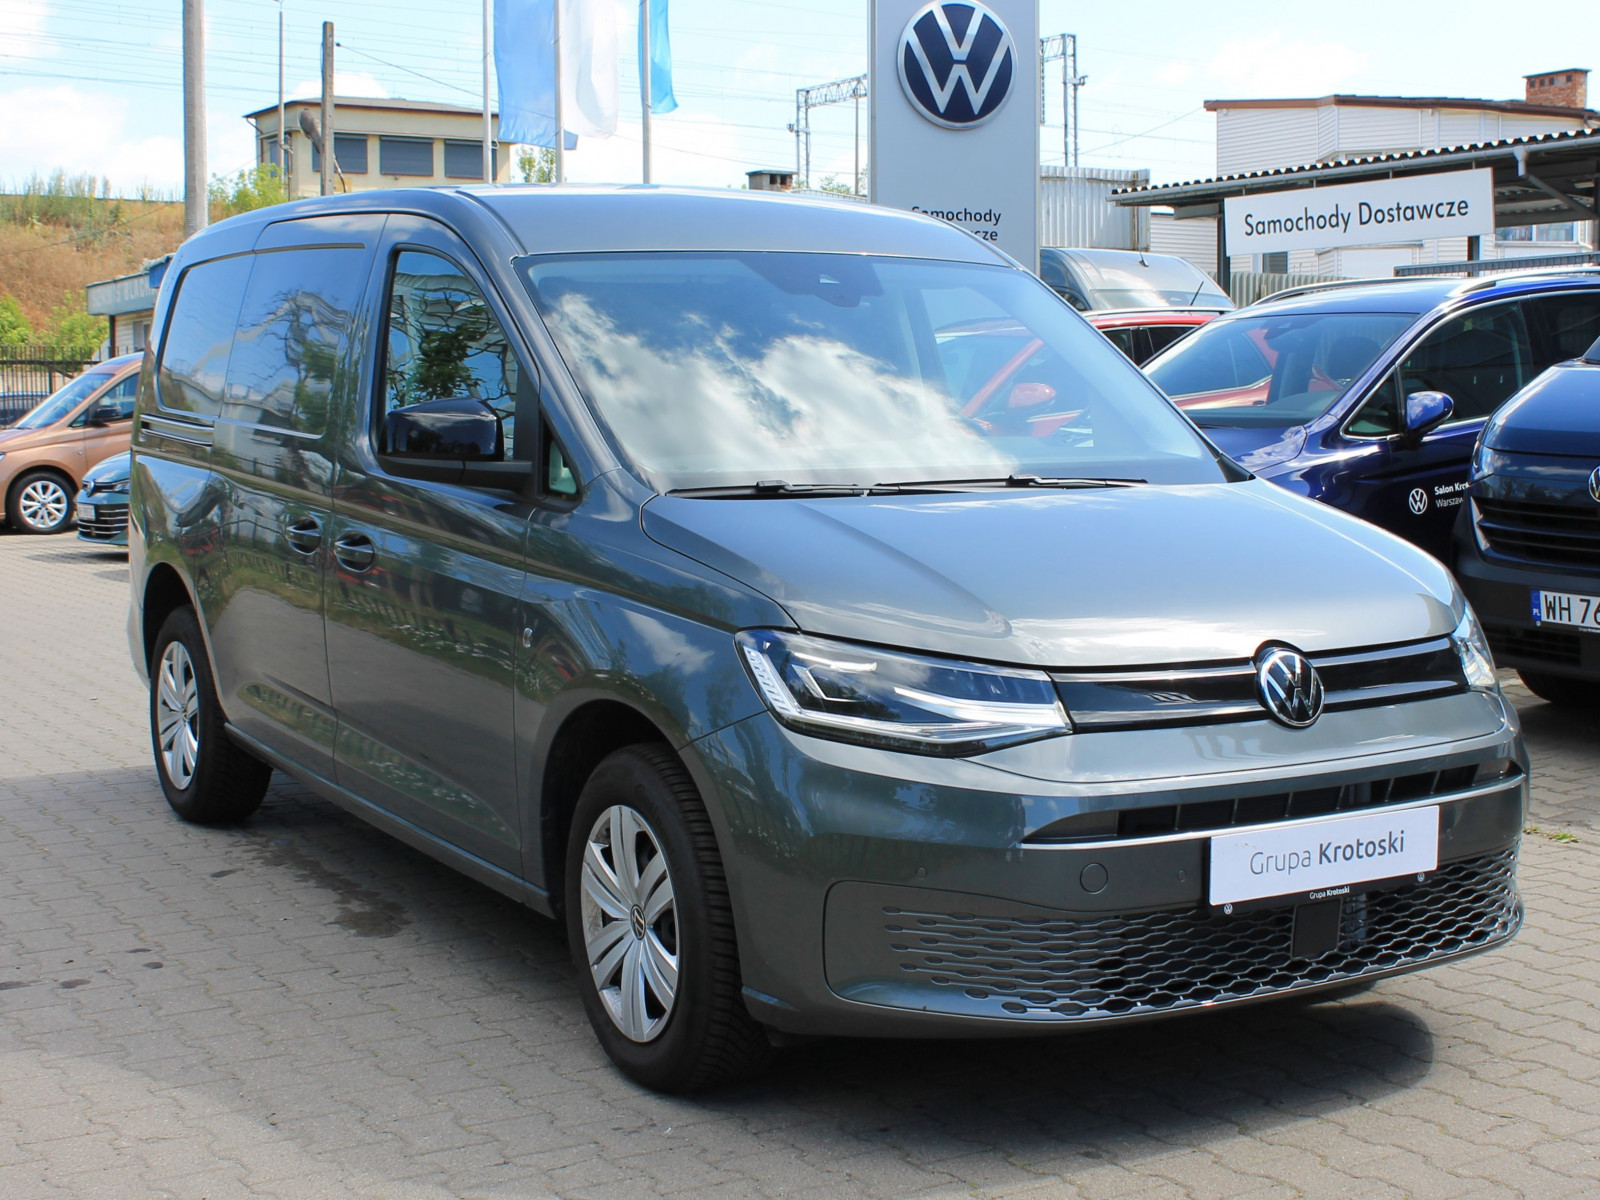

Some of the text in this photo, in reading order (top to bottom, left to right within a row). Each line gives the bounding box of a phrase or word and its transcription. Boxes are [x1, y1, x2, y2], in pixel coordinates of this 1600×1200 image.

[1244, 199, 1469, 233] Samochody Dostawcze
[1434, 484, 1454, 495] Salon
[1544, 594, 1571, 622] WH
[1250, 830, 1405, 875] Grupa Krotoski
[1309, 885, 1350, 900] Grupa Krotoski
